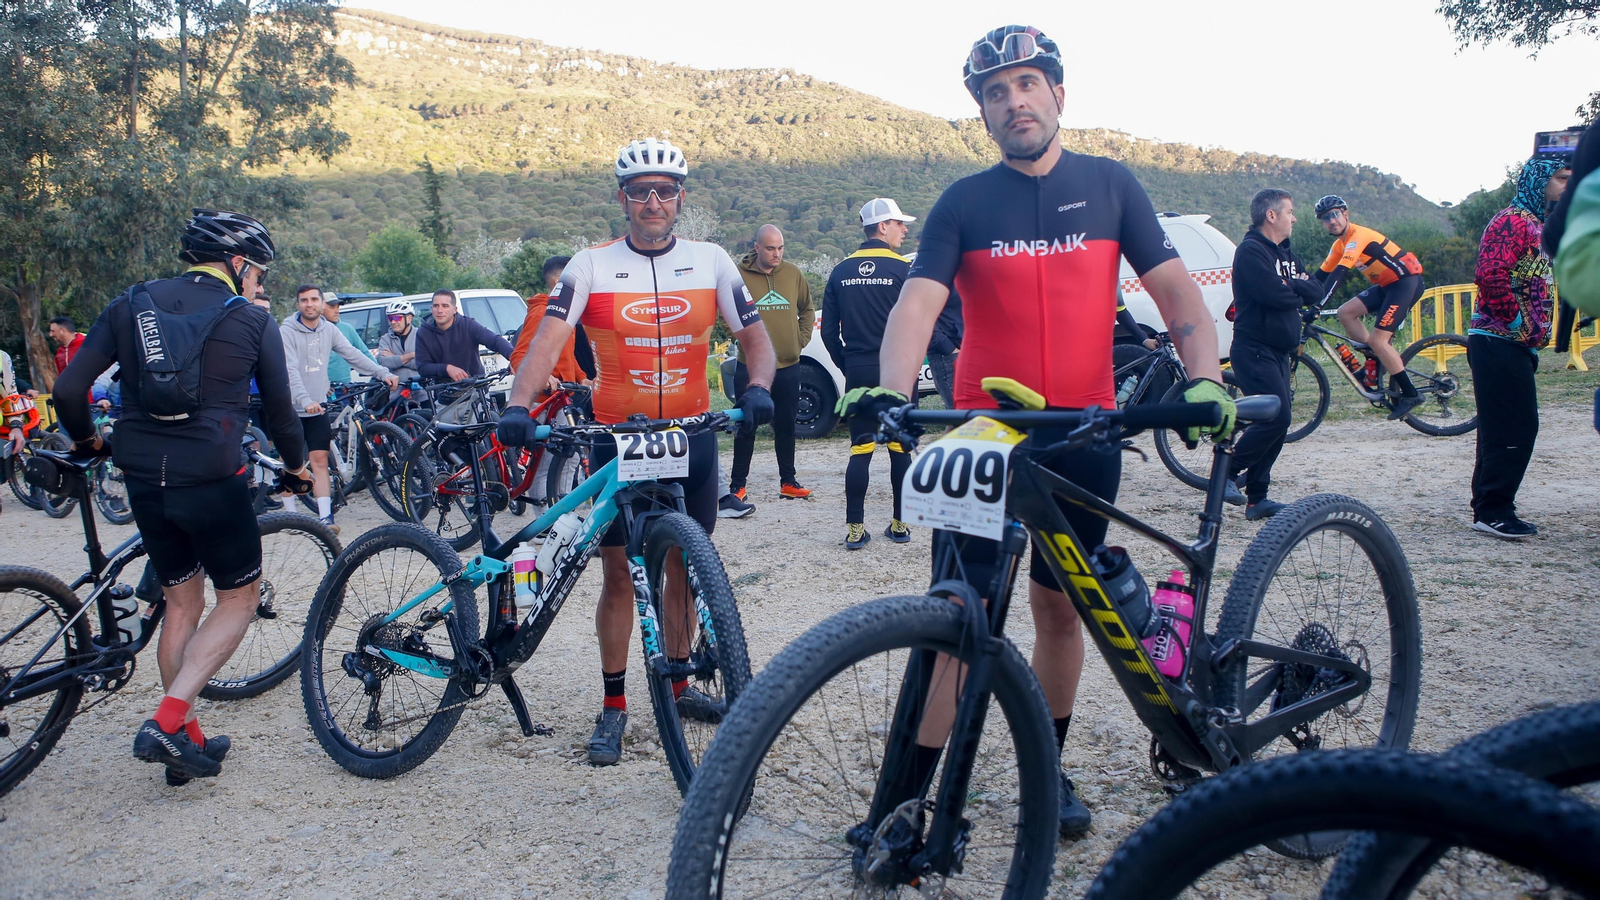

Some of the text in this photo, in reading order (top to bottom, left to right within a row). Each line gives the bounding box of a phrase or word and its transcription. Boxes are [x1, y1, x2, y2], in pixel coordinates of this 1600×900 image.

[1058, 201, 1087, 212] GSPORT
[991, 233, 1088, 258] RUNBAIK
[631, 305, 681, 315] SYMISUR
[137, 310, 165, 364] CAMELBAK
[620, 431, 688, 461] 280
[911, 446, 1005, 504] 009
[1326, 511, 1373, 528] MAXXIS
[344, 535, 384, 564] PHANTOM
[641, 618, 660, 657] FOX
[1039, 530, 1179, 715] SCOTT
[143, 726, 182, 758] SPECIALIZED
